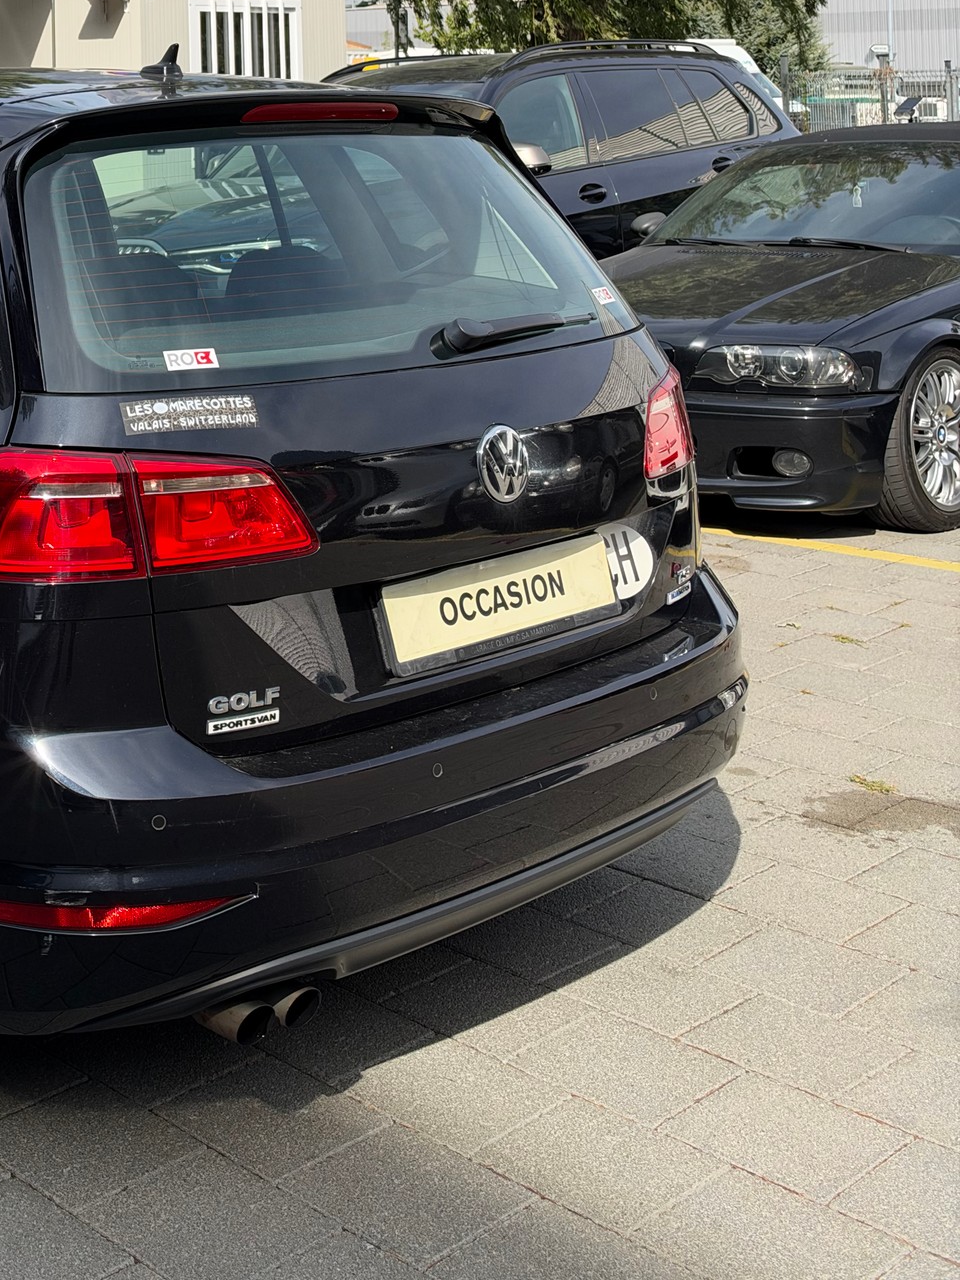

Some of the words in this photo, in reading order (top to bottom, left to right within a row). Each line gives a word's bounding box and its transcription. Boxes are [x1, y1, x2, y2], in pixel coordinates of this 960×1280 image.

[166, 351, 211, 367] ROC
[126, 403, 153, 417] LES
[169, 397, 252, 413] MARECOTTES
[130, 418, 171, 432] VALAIS
[179, 413, 257, 427] SWITZERLAND
[439, 570, 566, 626] OCCASION
[521, 631, 530, 640] SA
[207, 686, 281, 715] GOLF
[212, 713, 277, 732] SPORTSVAN
